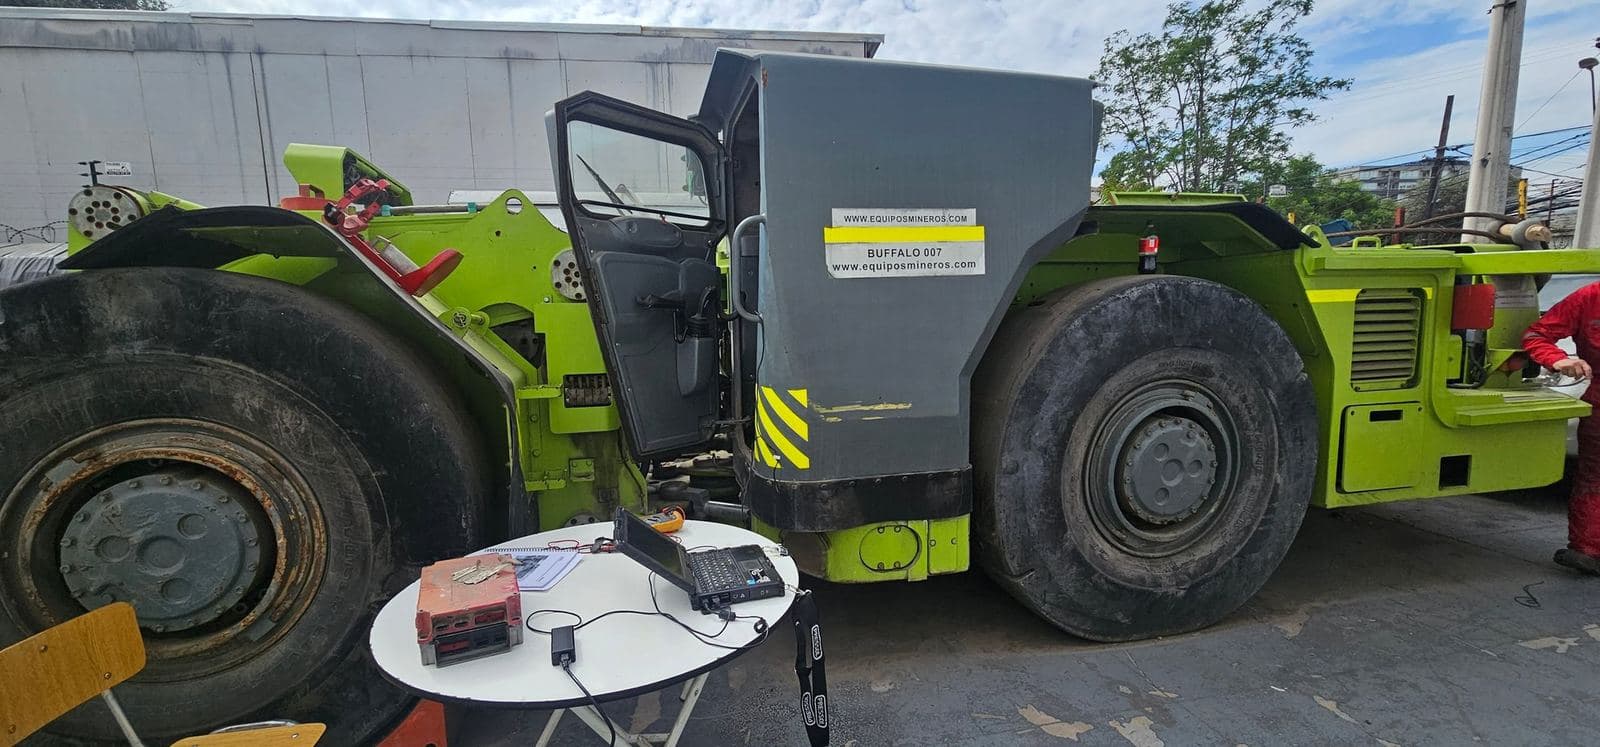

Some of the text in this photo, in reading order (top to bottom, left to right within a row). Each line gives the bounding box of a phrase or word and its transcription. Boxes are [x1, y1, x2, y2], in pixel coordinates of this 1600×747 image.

[844, 215, 967, 223] WWW.EQUIPOSMINEROS.COM
[867, 247, 942, 258] BUFFALO 007
[832, 260, 976, 273] www.equiposmineros.com
